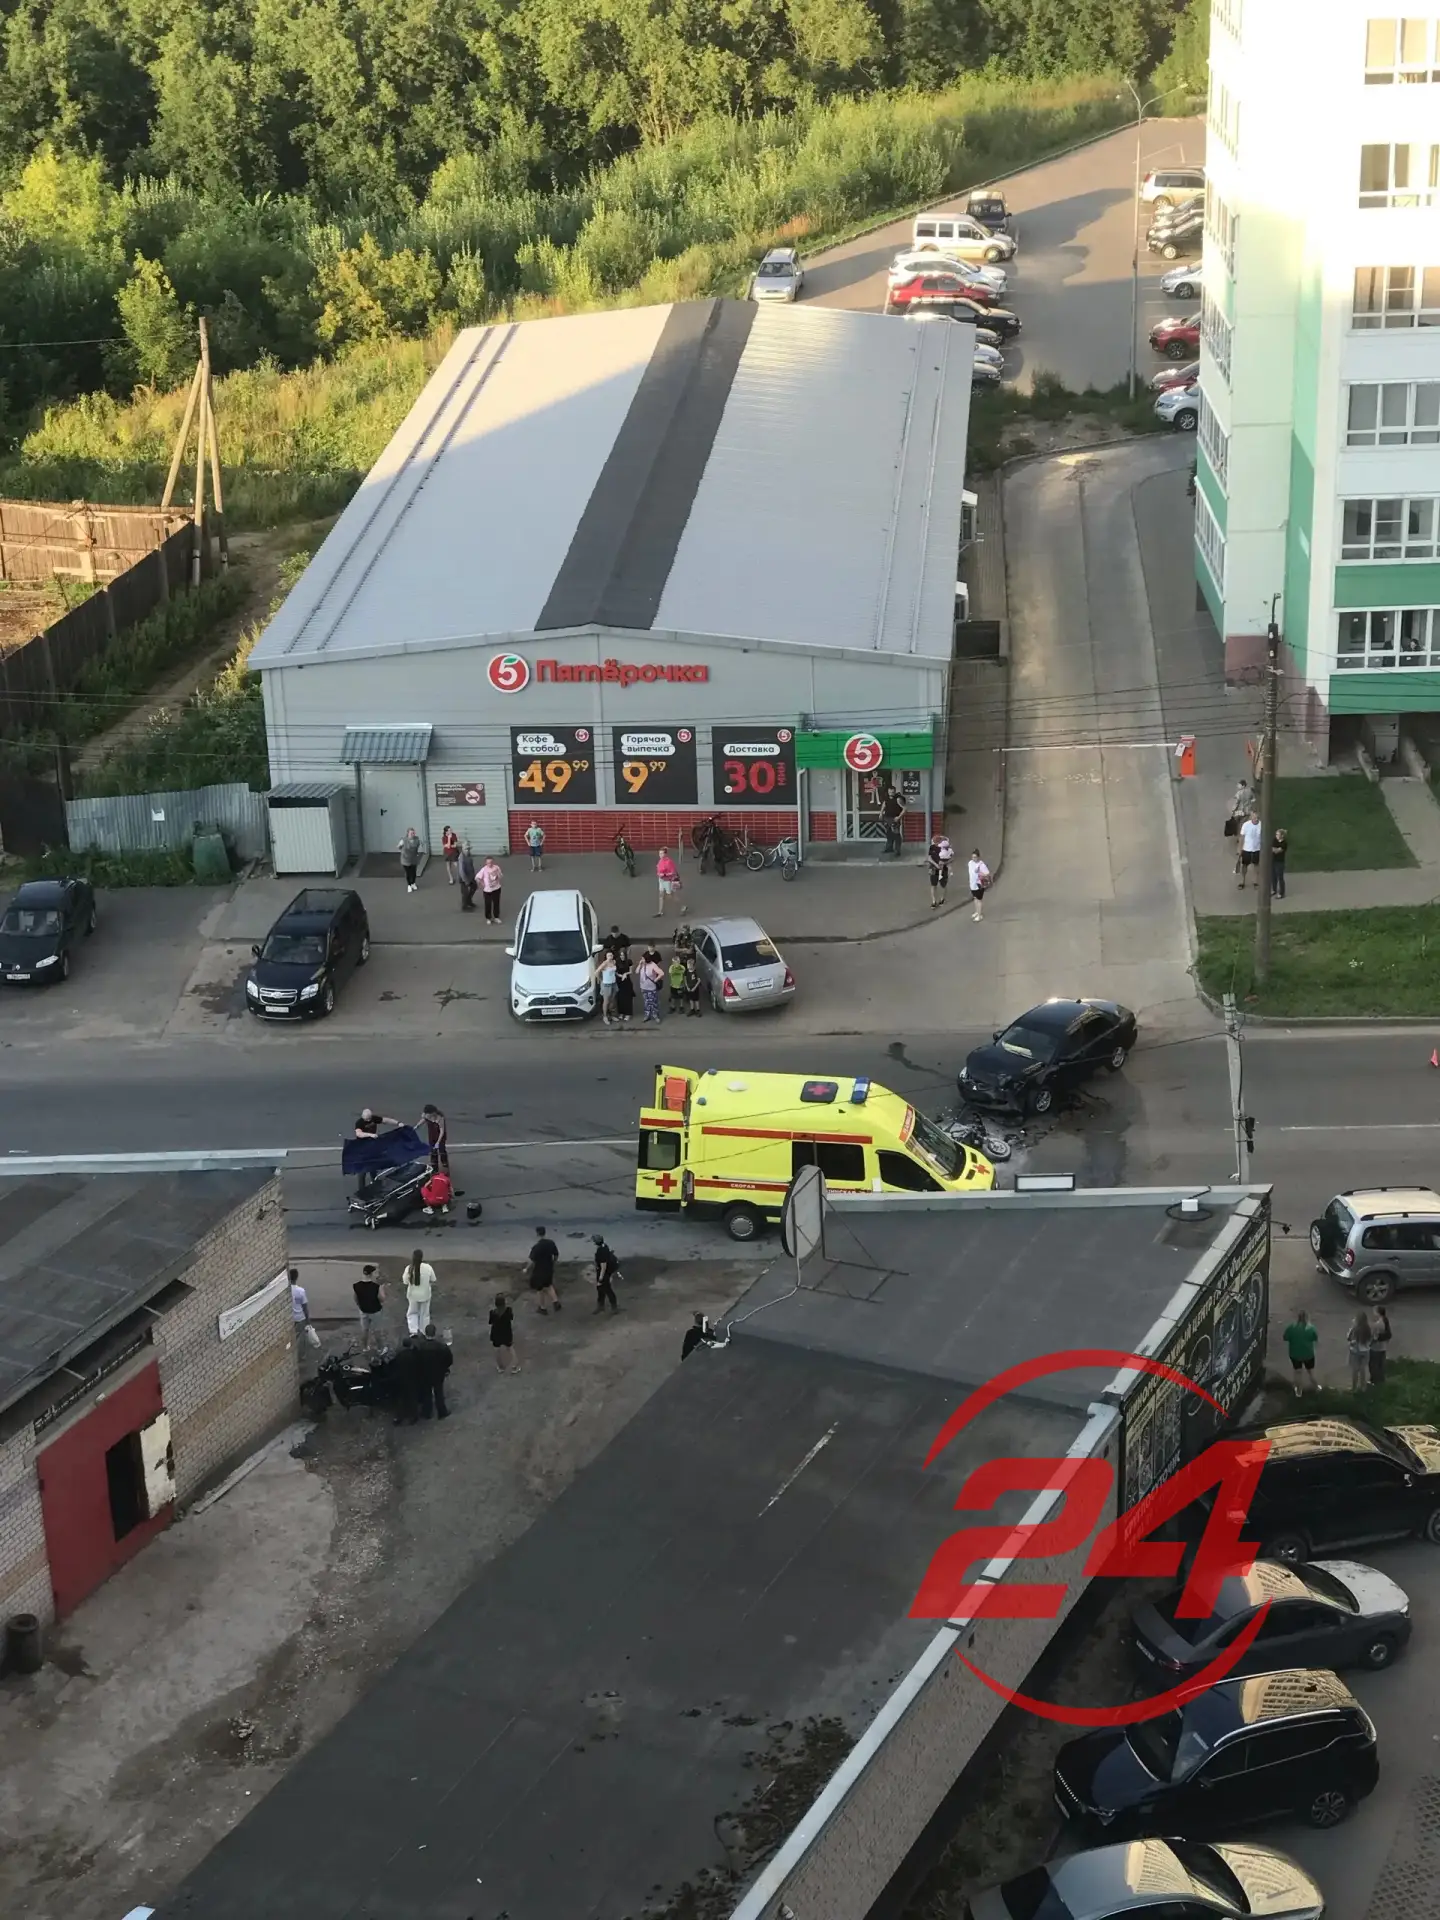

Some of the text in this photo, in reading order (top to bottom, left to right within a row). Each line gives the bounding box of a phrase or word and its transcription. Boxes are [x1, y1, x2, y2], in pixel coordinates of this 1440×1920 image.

[536, 659, 709, 688] Пятёрочка
[522, 735, 548, 744] Кофе
[626, 735, 667, 744] Горячая
[530, 744, 560, 753] собой
[627, 745, 670, 753] выпечка
[729, 745, 775, 753] Доставка
[518, 759, 589, 793] 49 99
[622, 761, 667, 793] 9 99
[723, 760, 776, 794] 30
